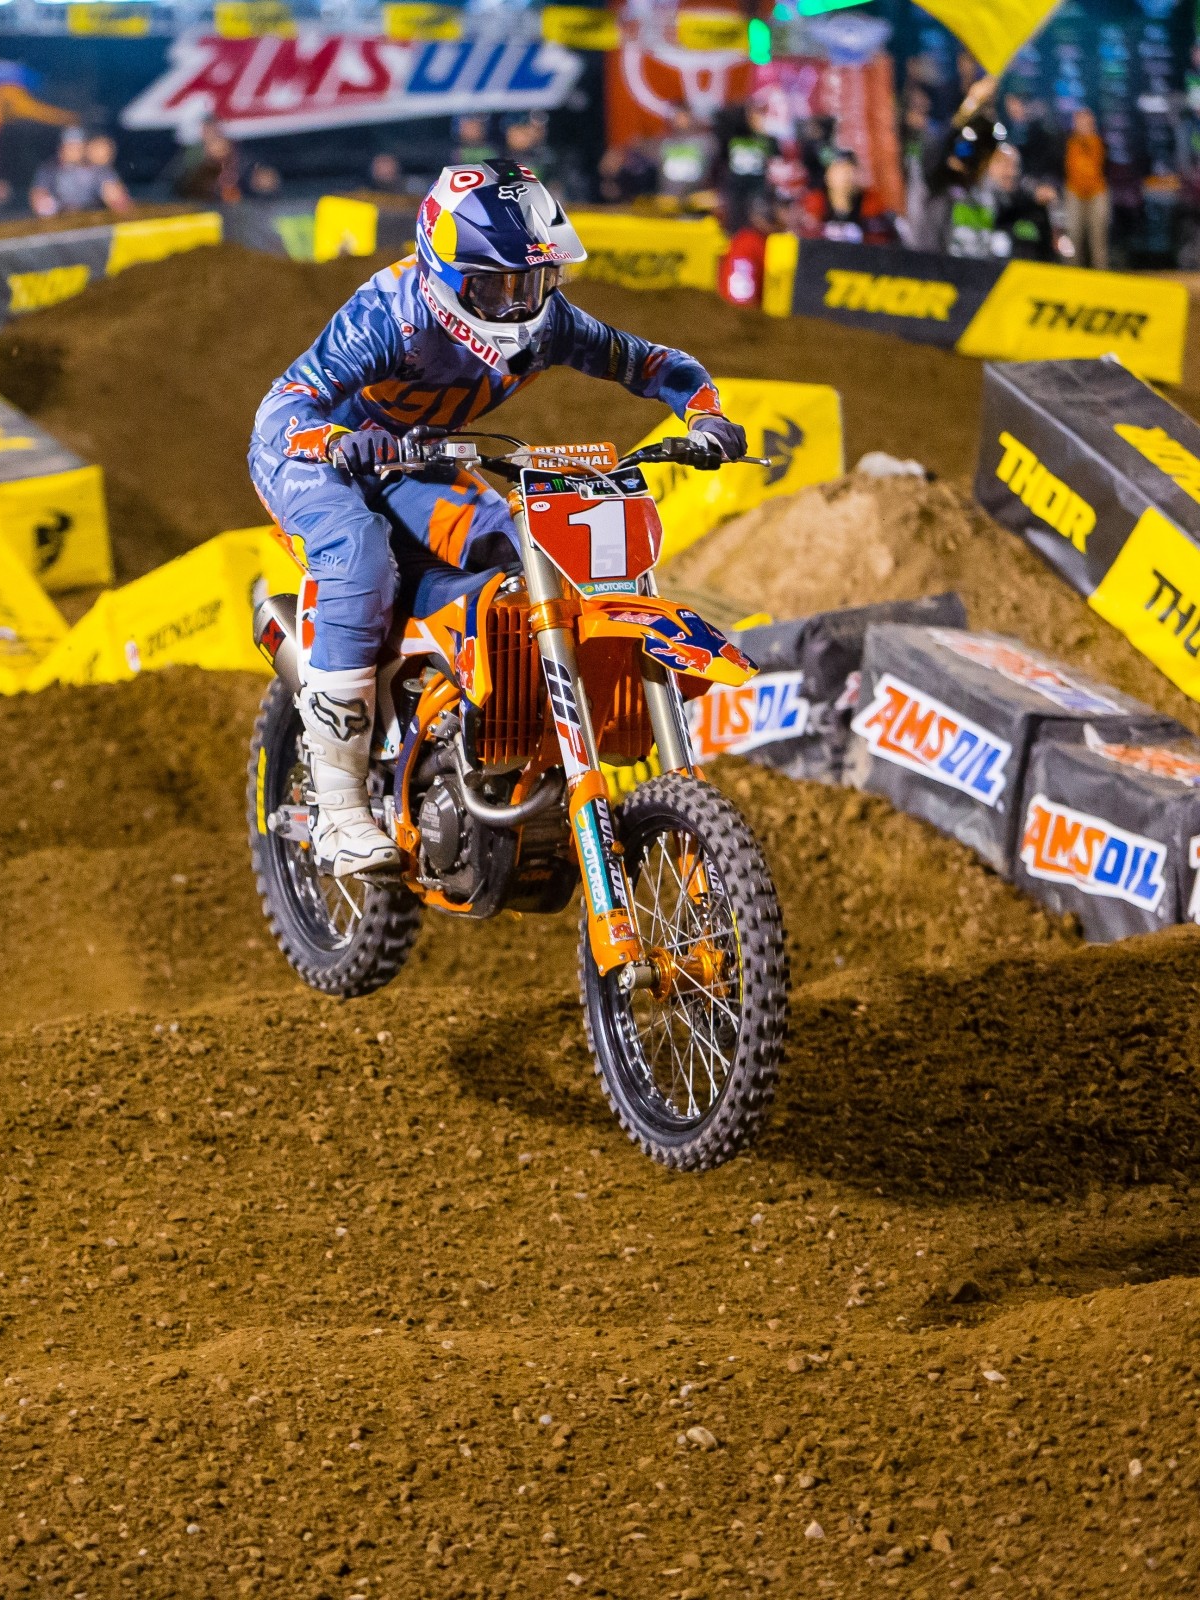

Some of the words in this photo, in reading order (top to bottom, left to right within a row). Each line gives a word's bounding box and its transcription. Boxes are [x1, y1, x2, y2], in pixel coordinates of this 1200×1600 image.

[162, 35, 568, 110] AMSOIL
[419, 272, 452, 330] Red
[452, 320, 500, 366] Bull
[824, 268, 959, 321] THOR
[1026, 299, 1150, 341] THOR
[535, 444, 609, 455] RENTHAL
[996, 430, 1097, 554] THOR
[568, 500, 626, 579] 1
[594, 582, 635, 592] MOTOREX
[864, 685, 1003, 794] AMSOIL
[579, 829, 608, 912] MOTOREX
[596, 798, 628, 908] DUNOP
[1024, 805, 1164, 900] AMSOIL
